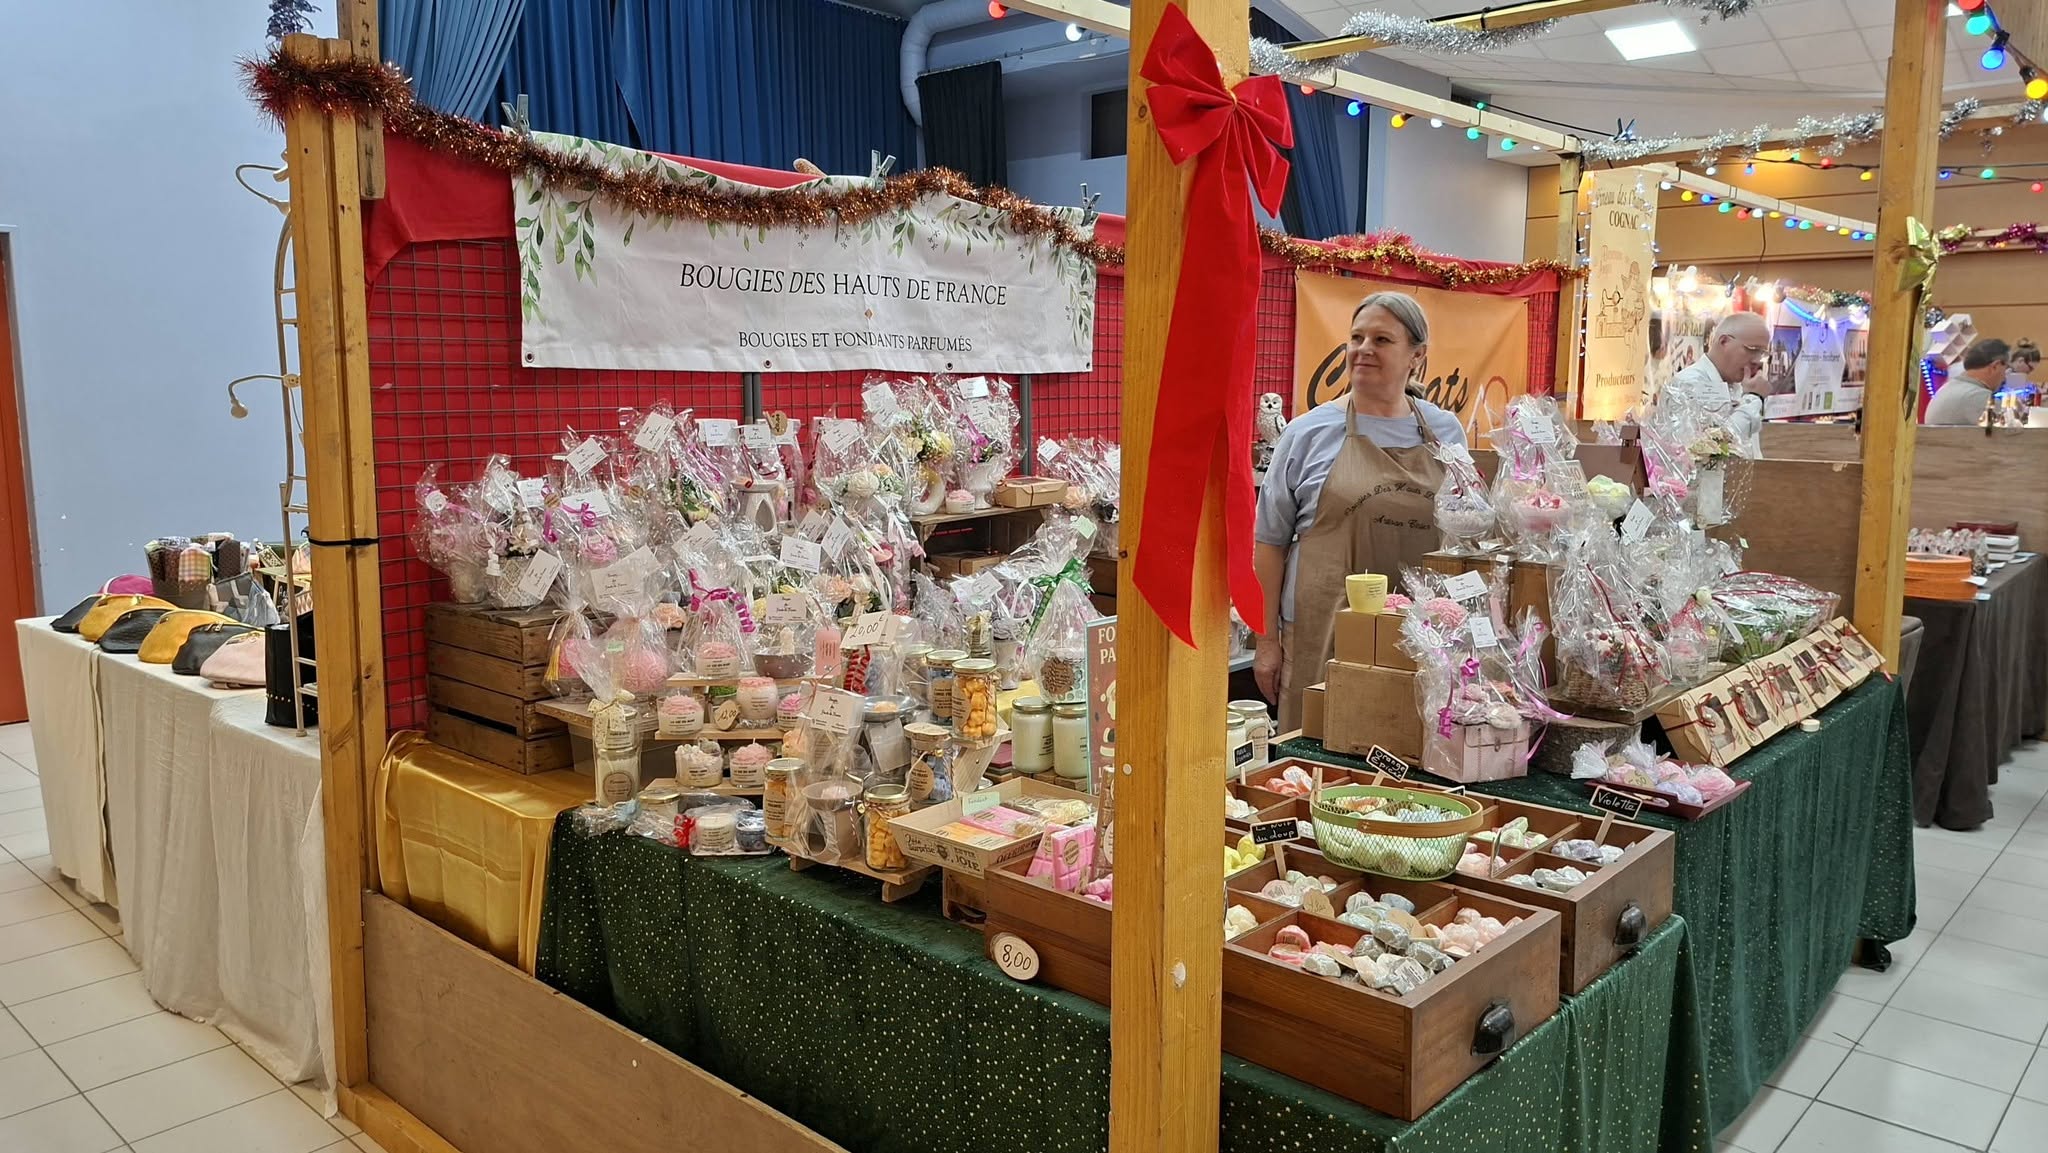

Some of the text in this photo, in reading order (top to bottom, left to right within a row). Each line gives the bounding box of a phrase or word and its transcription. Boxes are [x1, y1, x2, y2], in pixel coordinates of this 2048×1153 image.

[1609, 210, 1639, 230] COGNAC
[679, 263, 1007, 306] BOUGIES DES HAUTS DE FRANCE
[738, 331, 973, 352] BOUGIES ET FONDANTS PARFUMÉS
[1596, 372, 1636, 388] Producteurs
[1375, 750, 1406, 772] Orange
[1598, 791, 1638, 811] Violette
[1002, 943, 1032, 971] 8,00
